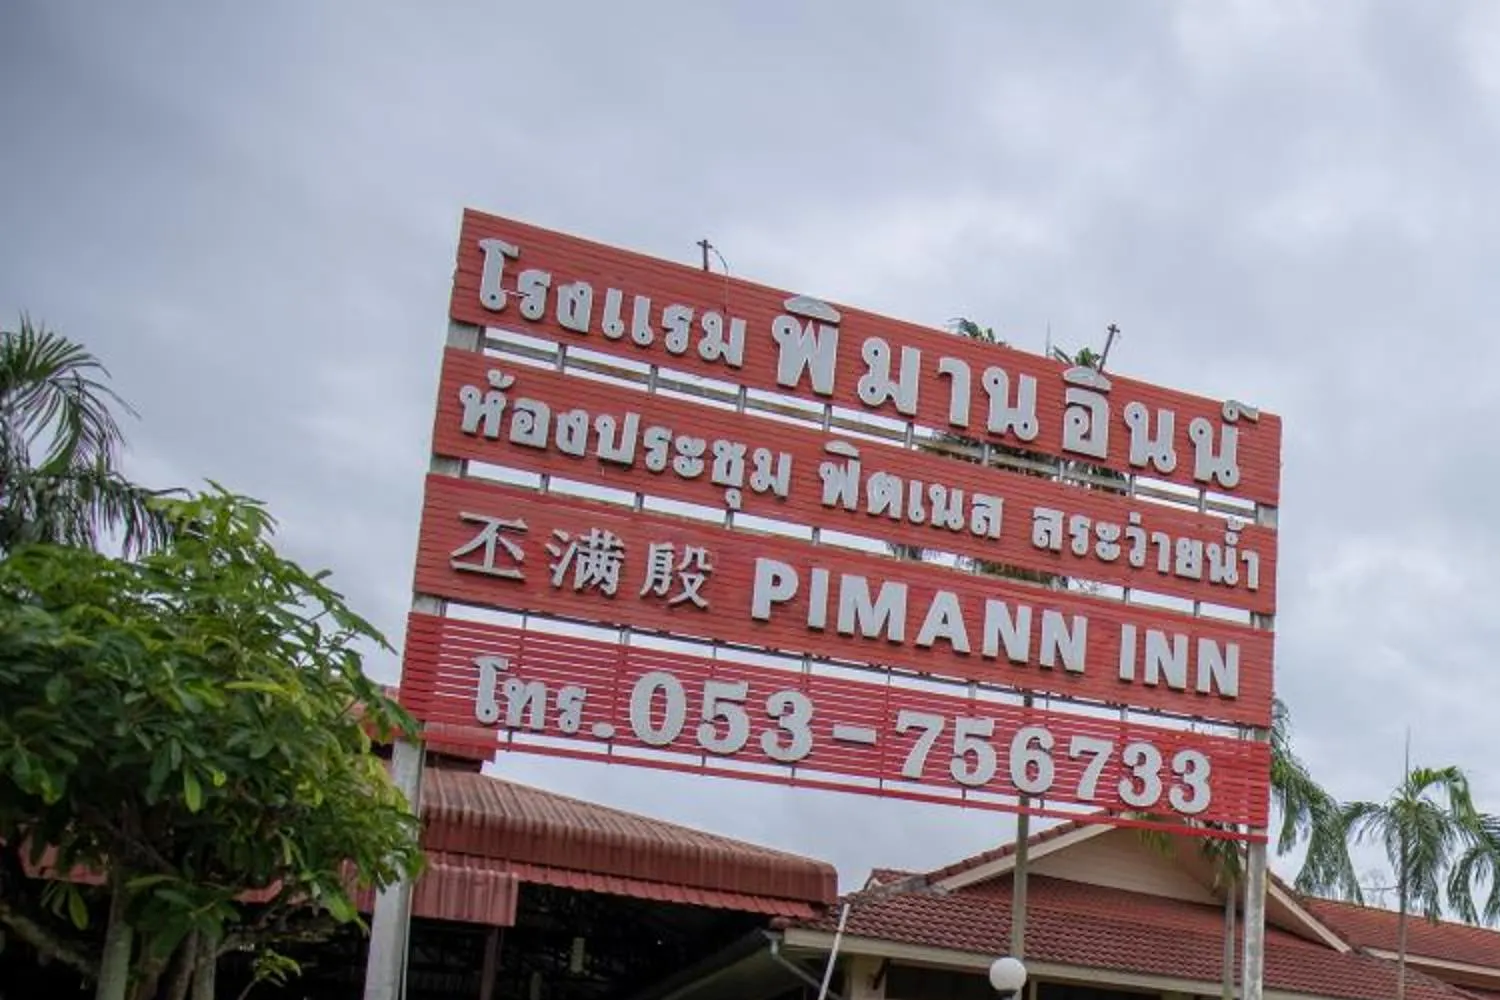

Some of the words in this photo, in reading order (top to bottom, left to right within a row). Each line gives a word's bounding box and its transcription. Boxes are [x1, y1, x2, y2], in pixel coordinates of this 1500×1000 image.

[478, 238, 747, 368] โรงแรม
[459, 369, 792, 510] ห้องประชุม
[819, 440, 1004, 540] ฟิตเนส
[1032, 506, 1259, 590] สระว่ายน้ำ
[751, 557, 1088, 673] PIMANN
[1119, 624, 1240, 698] INN
